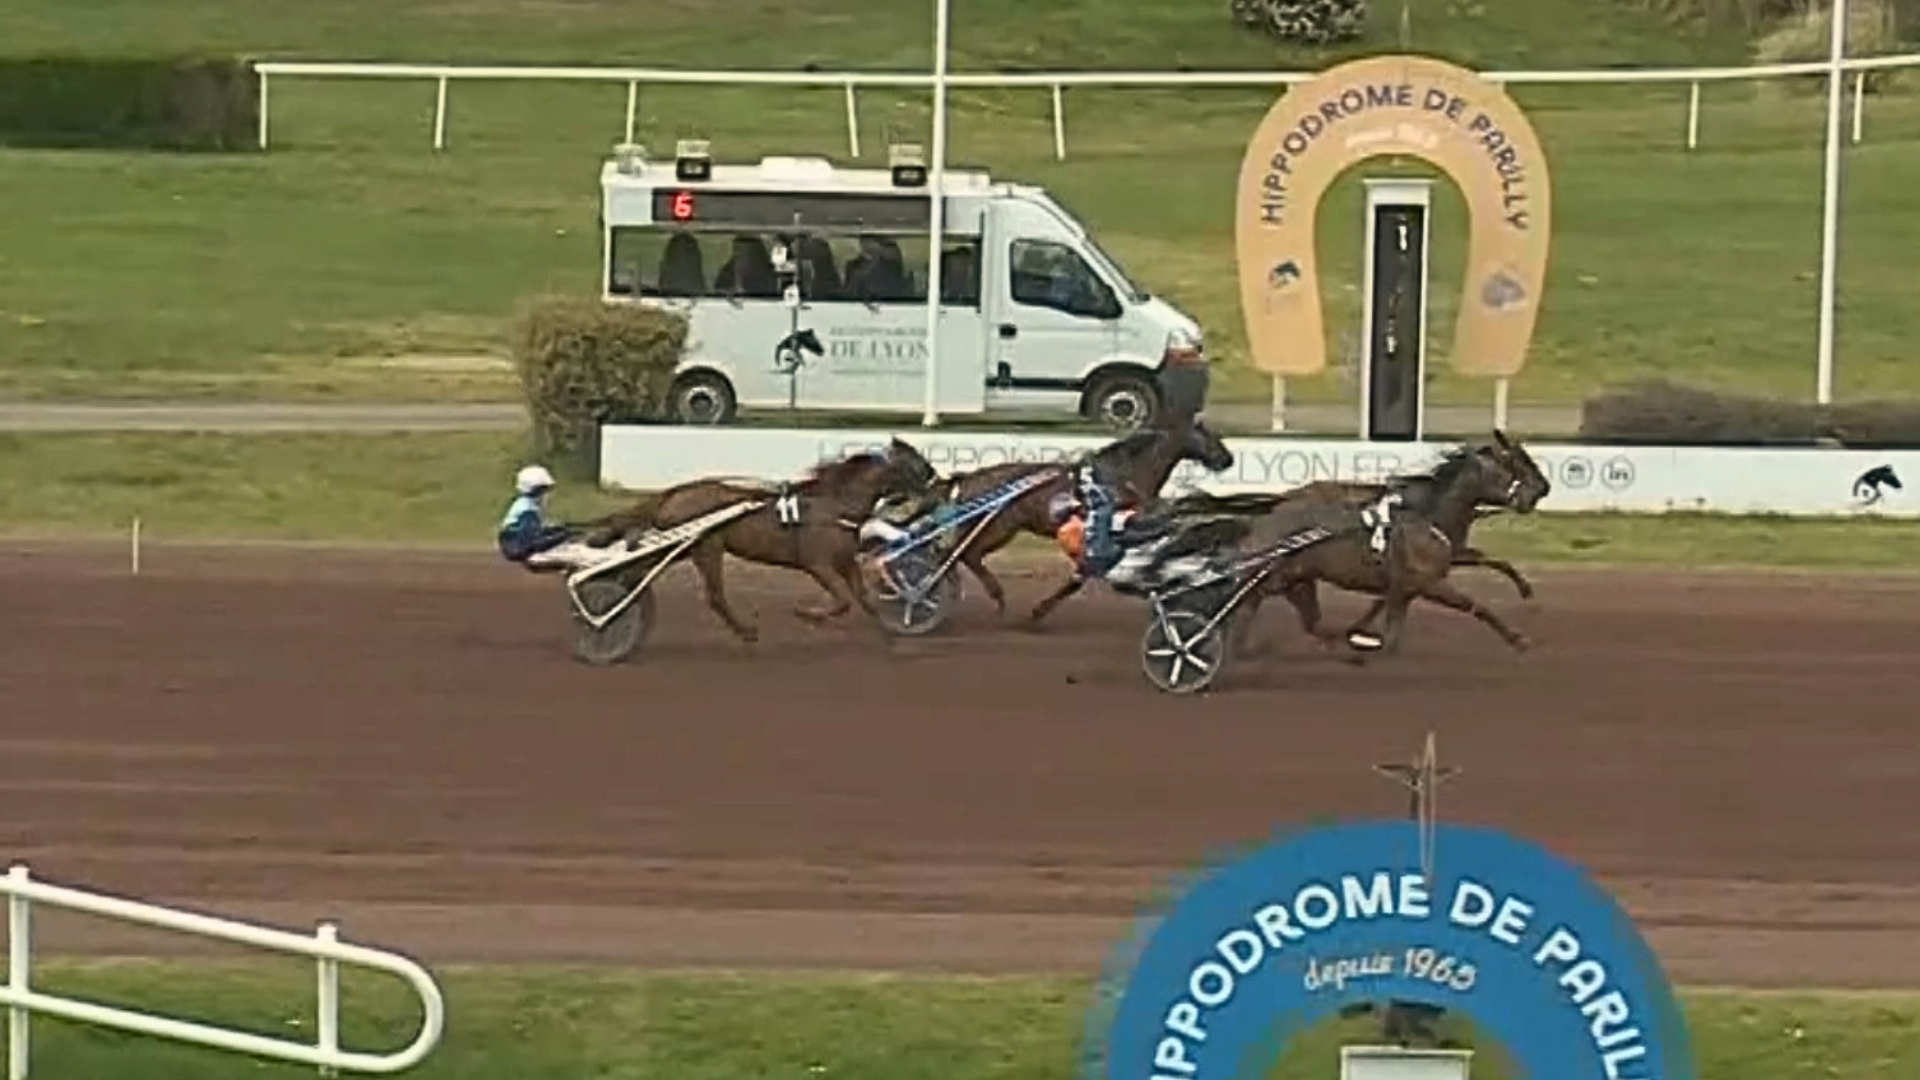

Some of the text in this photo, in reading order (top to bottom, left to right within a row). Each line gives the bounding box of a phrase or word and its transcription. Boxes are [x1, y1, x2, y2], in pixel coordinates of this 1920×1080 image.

[1261, 84, 1413, 224] HIPPODROME
[1423, 88, 1466, 123] DE
[674, 193, 692, 218] 6
[828, 340, 862, 358] DE
[776, 494, 799, 522] 11
[1450, 880, 1535, 945] DE
[1304, 953, 1394, 991] depuis
